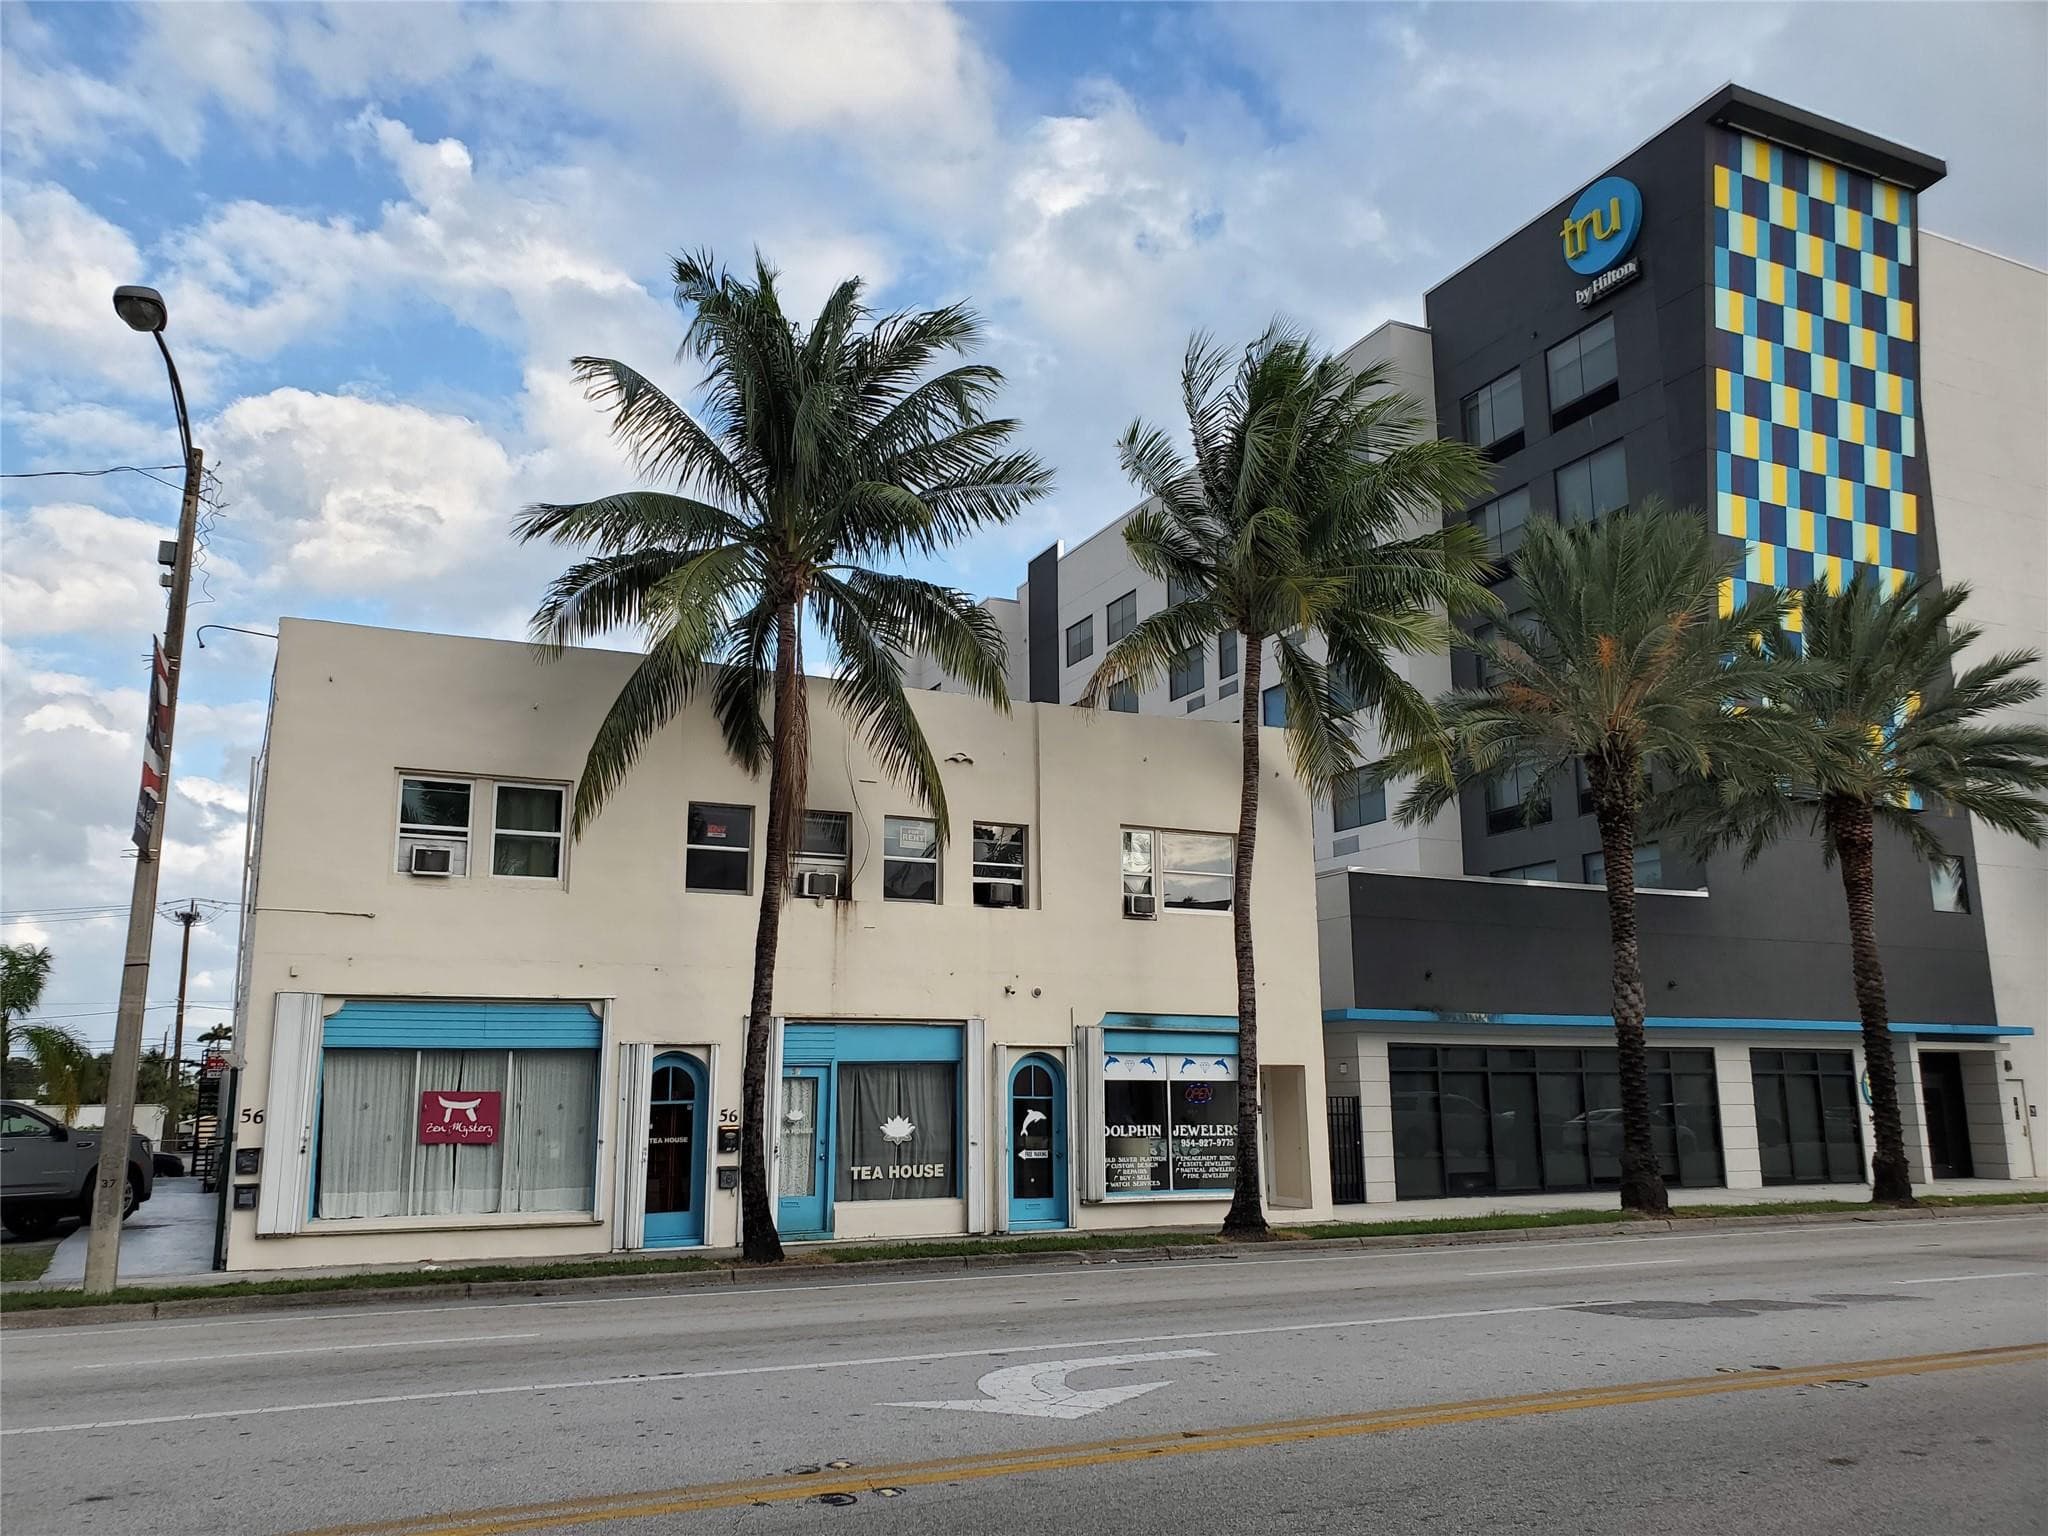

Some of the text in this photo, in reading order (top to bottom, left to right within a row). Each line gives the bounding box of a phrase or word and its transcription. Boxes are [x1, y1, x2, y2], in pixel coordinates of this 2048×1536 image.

[1560, 197, 1621, 260] tru
[1575, 261, 1638, 304] by Hilton
[240, 1108, 264, 1124] 56
[719, 1109, 738, 1122] 56
[425, 1121, 493, 1138] Zen Mystery
[1104, 1124, 1239, 1137] DOLPHIN JEWELERS
[664, 1136, 689, 1144] HOUSE
[1181, 1138, 1234, 1147] 954-927-9775
[850, 1163, 945, 1180] TEA HOUSE
